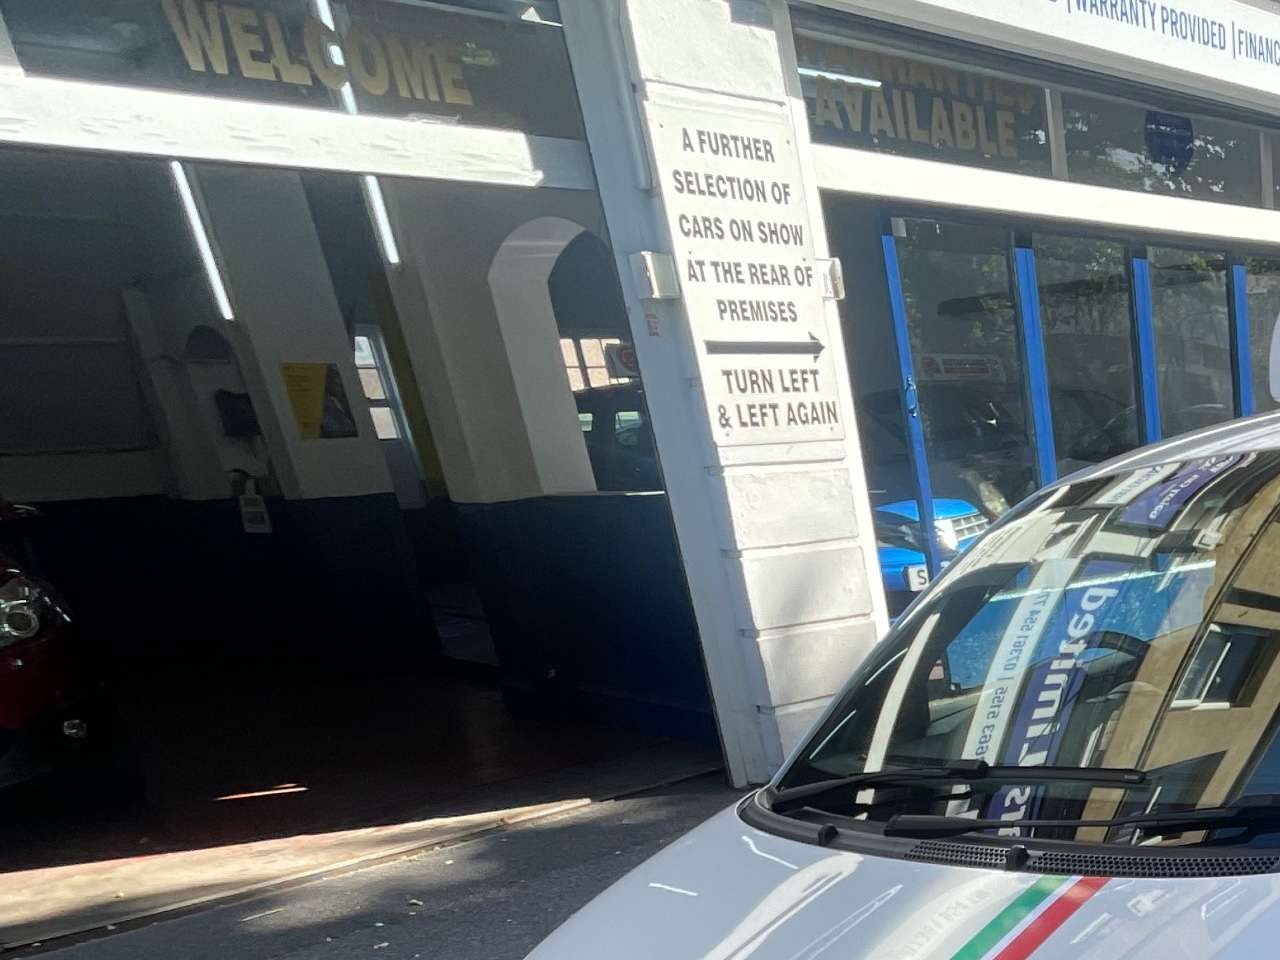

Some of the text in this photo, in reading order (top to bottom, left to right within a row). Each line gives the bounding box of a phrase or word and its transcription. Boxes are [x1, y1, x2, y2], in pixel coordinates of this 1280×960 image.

[1161, 6, 1226, 50] PROVIDED
[162, 0, 473, 105] WELCOME
[816, 74, 1018, 159] AVAILABLE
[682, 128, 775, 163] A FURTHER
[673, 169, 791, 205] SELECTION OF
[679, 214, 803, 246] CARS ON SHOW
[688, 259, 813, 287] AT THE REAR OF
[716, 298, 798, 323] PREMISES
[722, 368, 819, 394] TURN LEFT
[718, 401, 839, 429] & LEFT AGAIN
